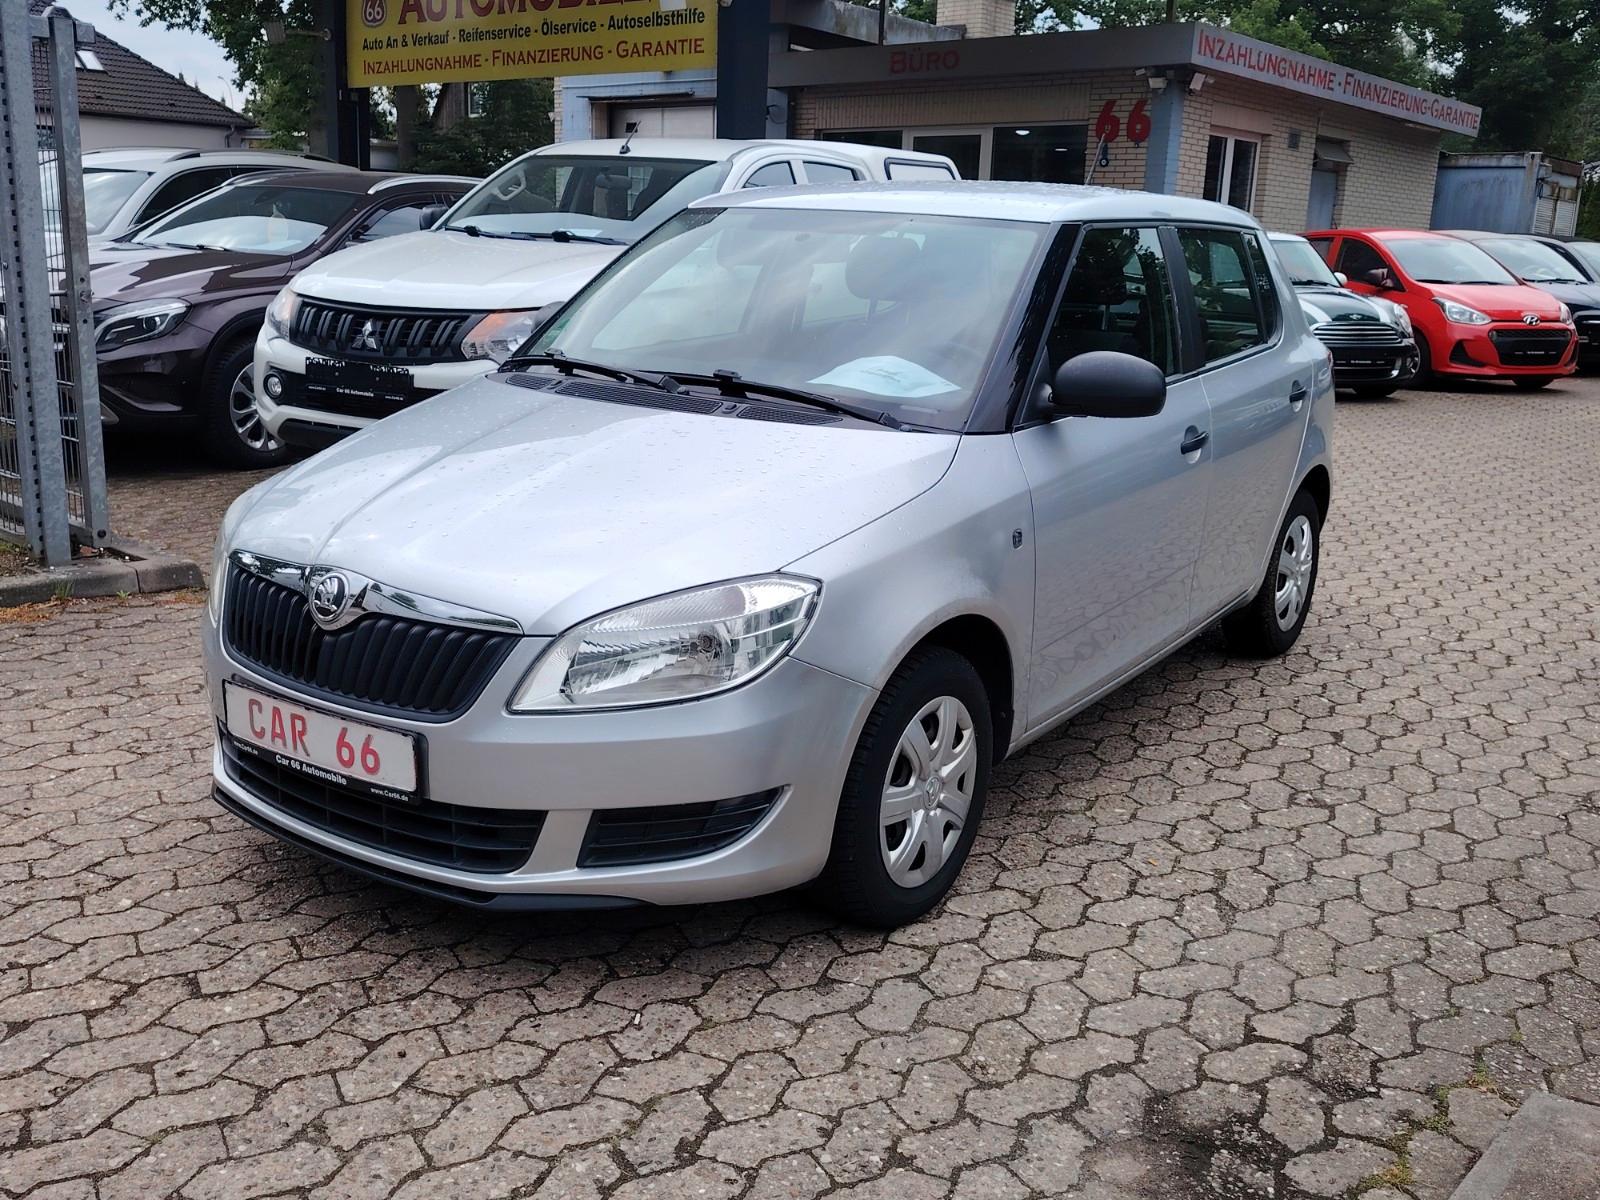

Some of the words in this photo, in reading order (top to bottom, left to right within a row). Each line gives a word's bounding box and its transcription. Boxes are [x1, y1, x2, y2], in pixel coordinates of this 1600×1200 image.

[362, 38, 383, 51] Auto
[386, 36, 398, 49] An
[401, 34, 408, 47] &
[411, 30, 449, 47] Verkauf
[459, 24, 531, 43] Reifenservice
[541, 18, 597, 36] Ölservice
[607, 8, 705, 31] Autoselbsthilfe
[363, 54, 482, 75] INZAHLUNGNAHME
[492, 46, 604, 66] FINANZIERUNG
[616, 38, 705, 58] GARANTIE
[889, 47, 960, 74] BÜRO
[1197, 29, 1336, 92] INZAHLUNGNAHME
[248, 699, 310, 757] CAR
[336, 727, 380, 775] 66
[276, 755, 289, 767] Car
[290, 760, 300, 770] 66
[302, 764, 347, 785] Automobile
